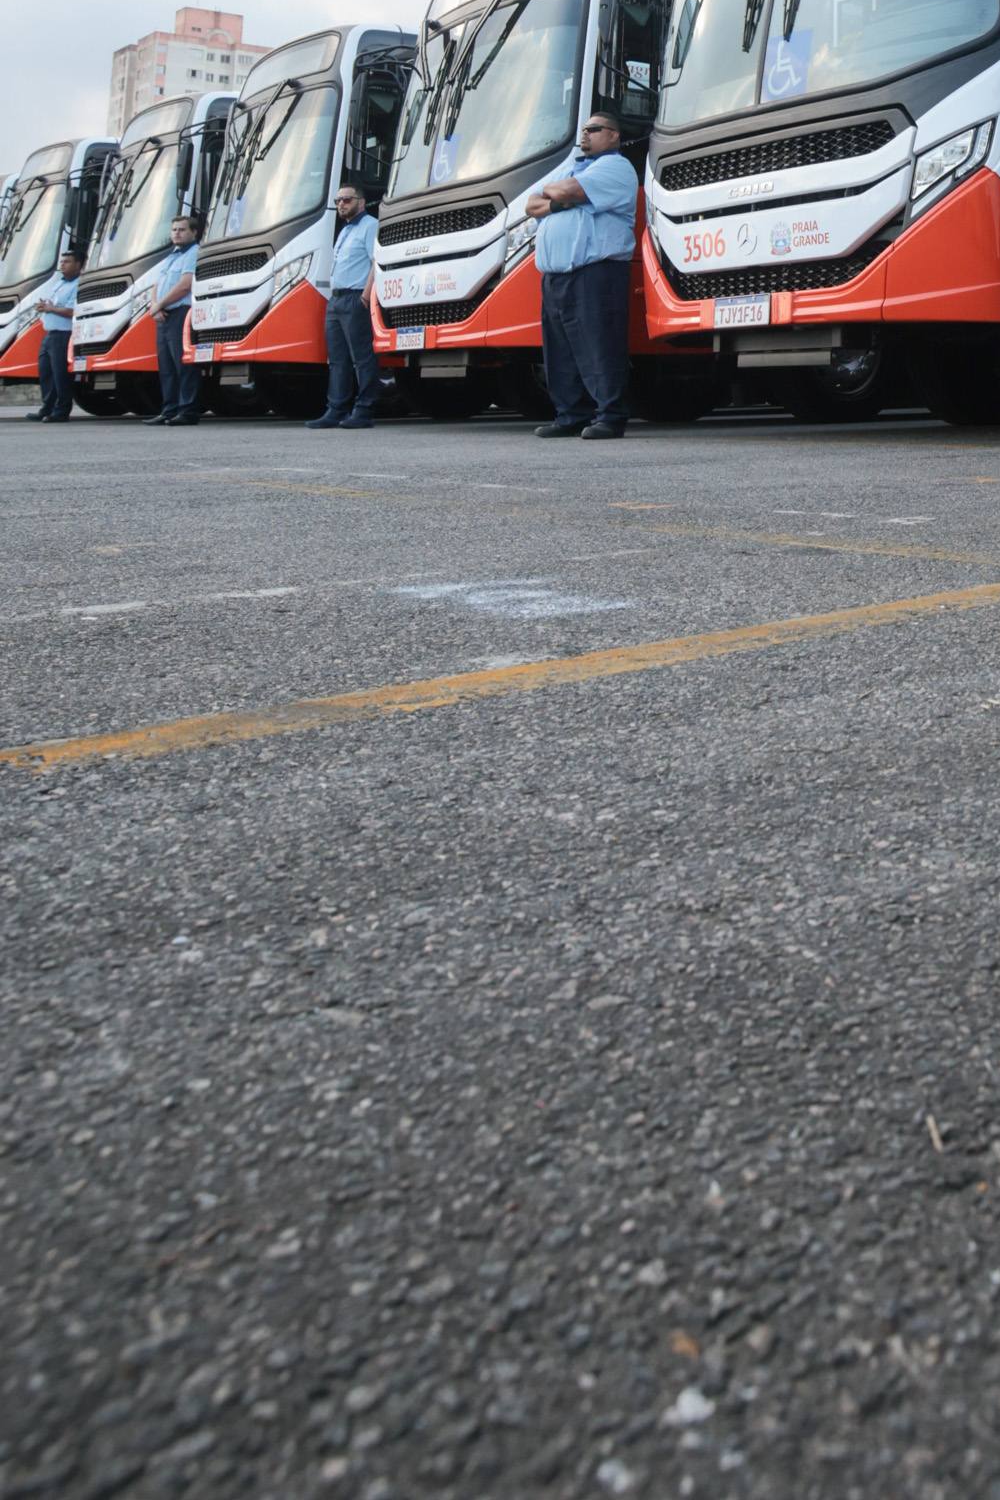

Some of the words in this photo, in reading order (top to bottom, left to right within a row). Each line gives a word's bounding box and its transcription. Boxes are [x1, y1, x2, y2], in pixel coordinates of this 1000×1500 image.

[727, 180, 775, 200] CAIO
[792, 220, 819, 234] PRAIA
[683, 228, 726, 264] 3506
[793, 232, 830, 248] GRANDE
[383, 278, 403, 301] 3505
[719, 304, 763, 325] TJY1F16
